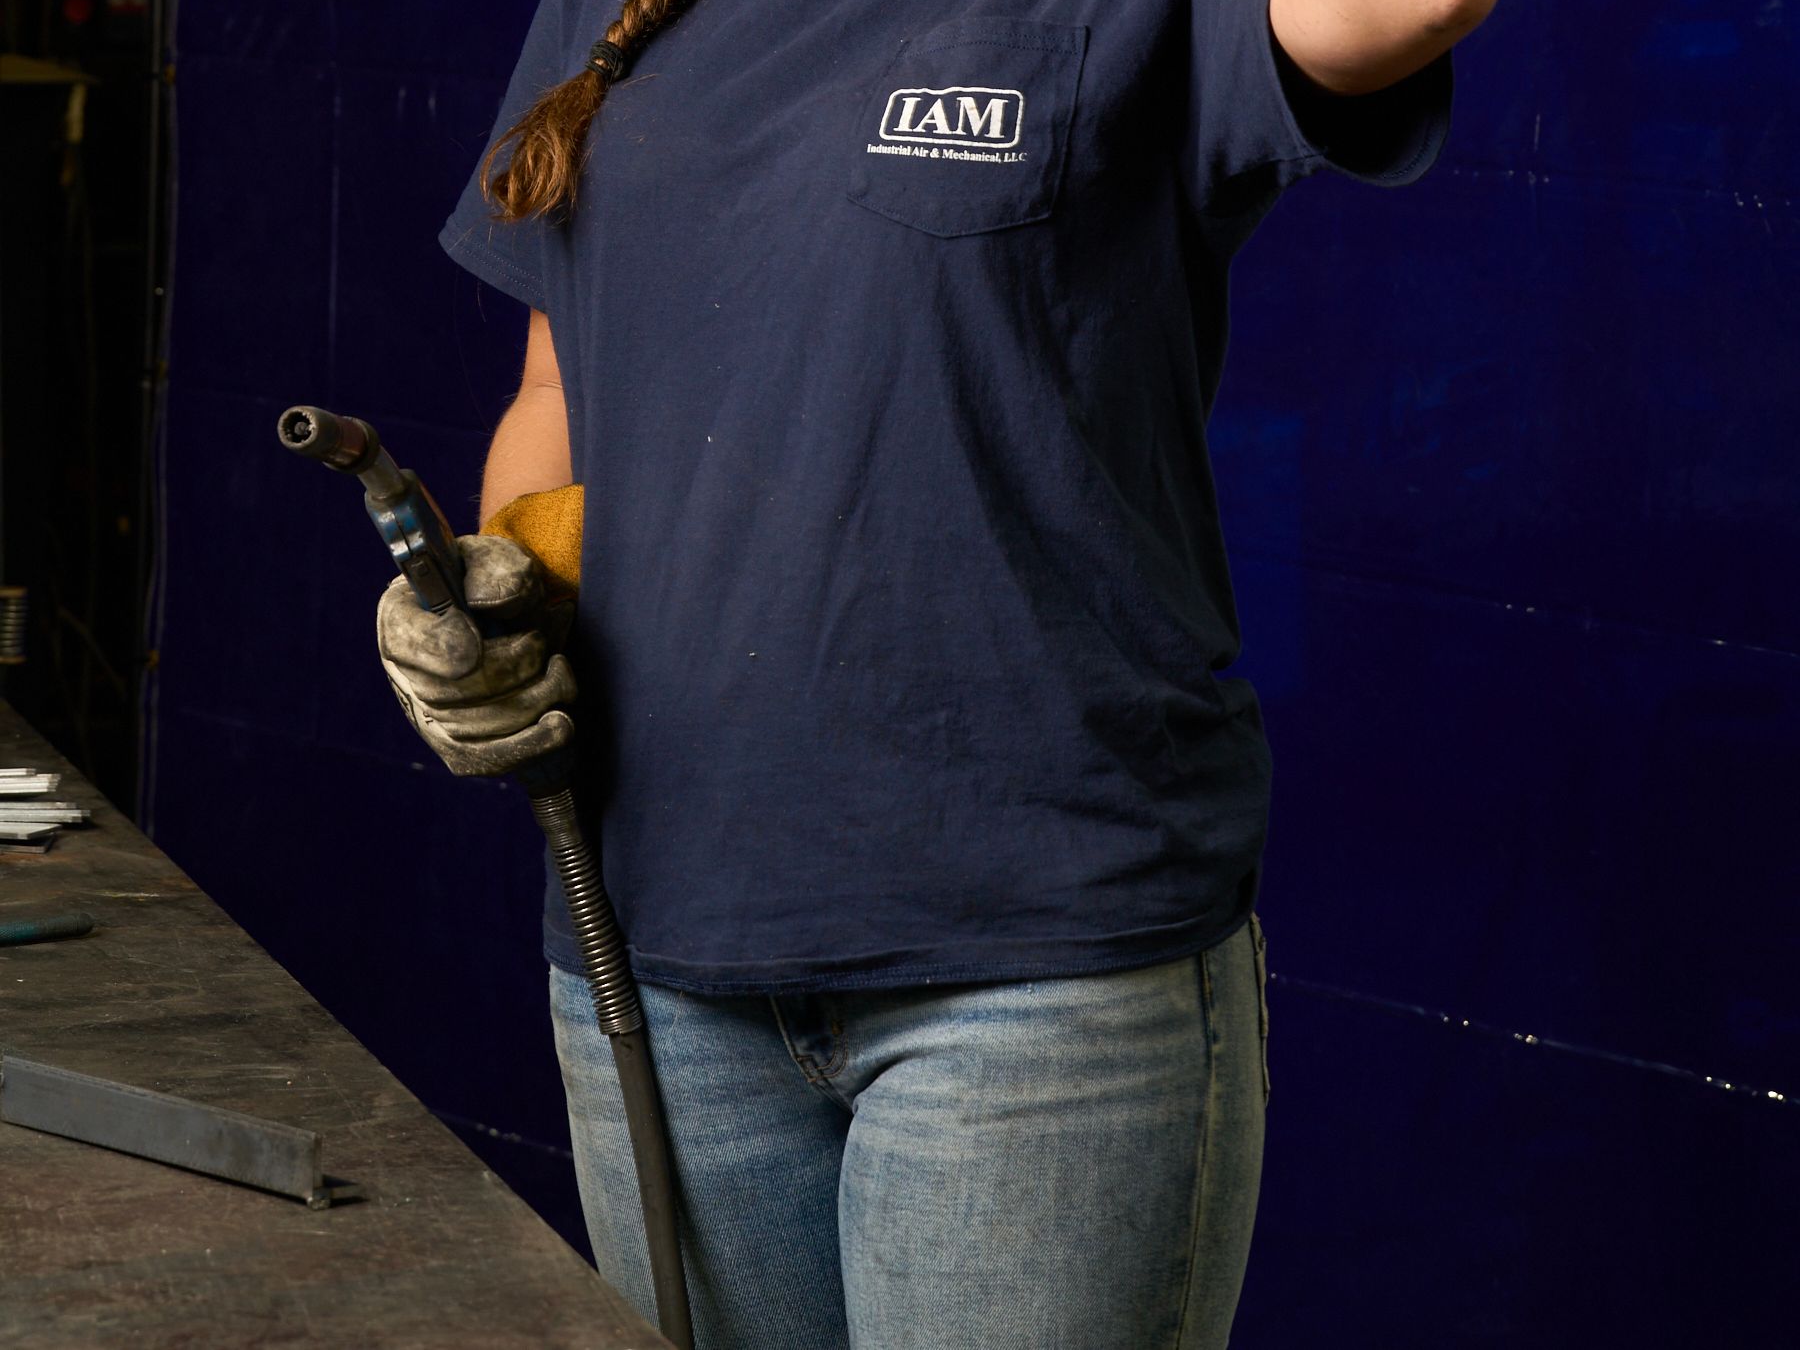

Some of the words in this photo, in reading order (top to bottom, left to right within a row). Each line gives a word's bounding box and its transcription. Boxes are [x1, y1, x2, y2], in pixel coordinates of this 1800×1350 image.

[893, 96, 1009, 139] IAM
[867, 144, 911, 156] Industrial
[912, 148, 929, 158] Air
[930, 148, 940, 158] &
[942, 149, 1001, 163] Mechanical,
[1003, 152, 1027, 163] LLC
